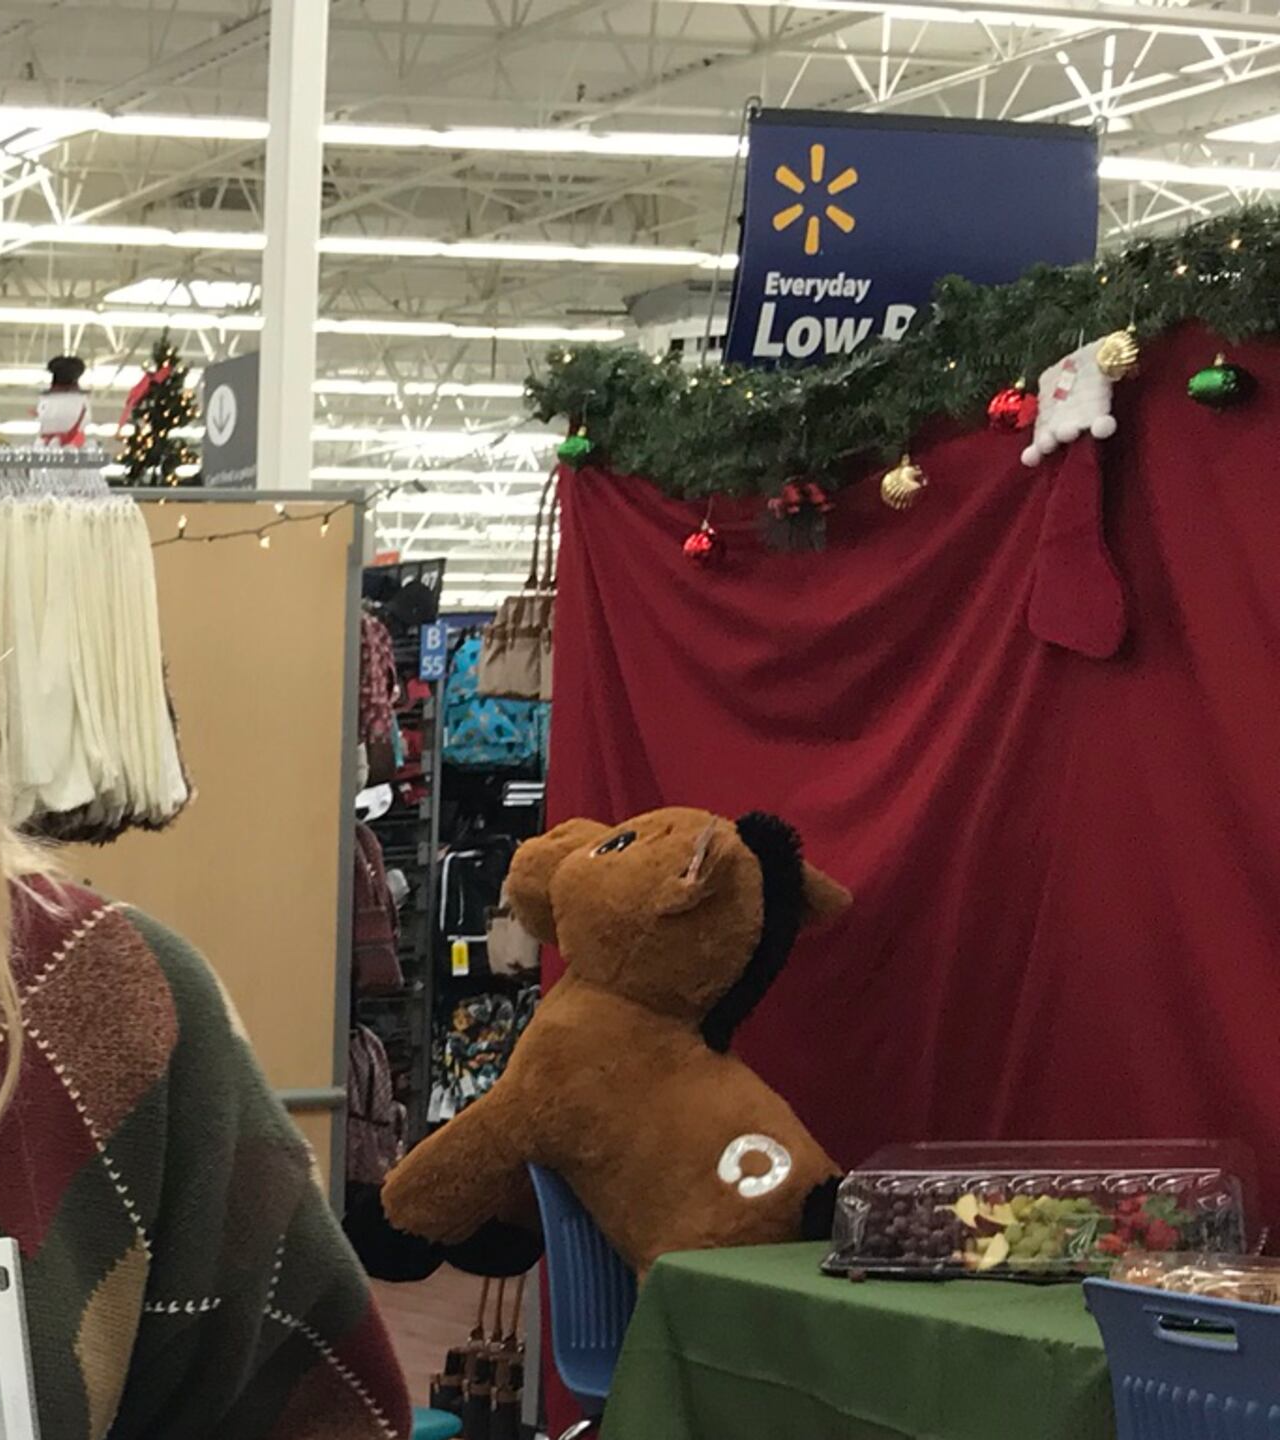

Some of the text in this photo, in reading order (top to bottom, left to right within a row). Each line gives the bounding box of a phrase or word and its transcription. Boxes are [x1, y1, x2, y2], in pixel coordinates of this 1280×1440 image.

[765, 271, 872, 304] Everyday
[752, 301, 874, 359] Low
[427, 628, 441, 650] B
[421, 656, 443, 675] 55
